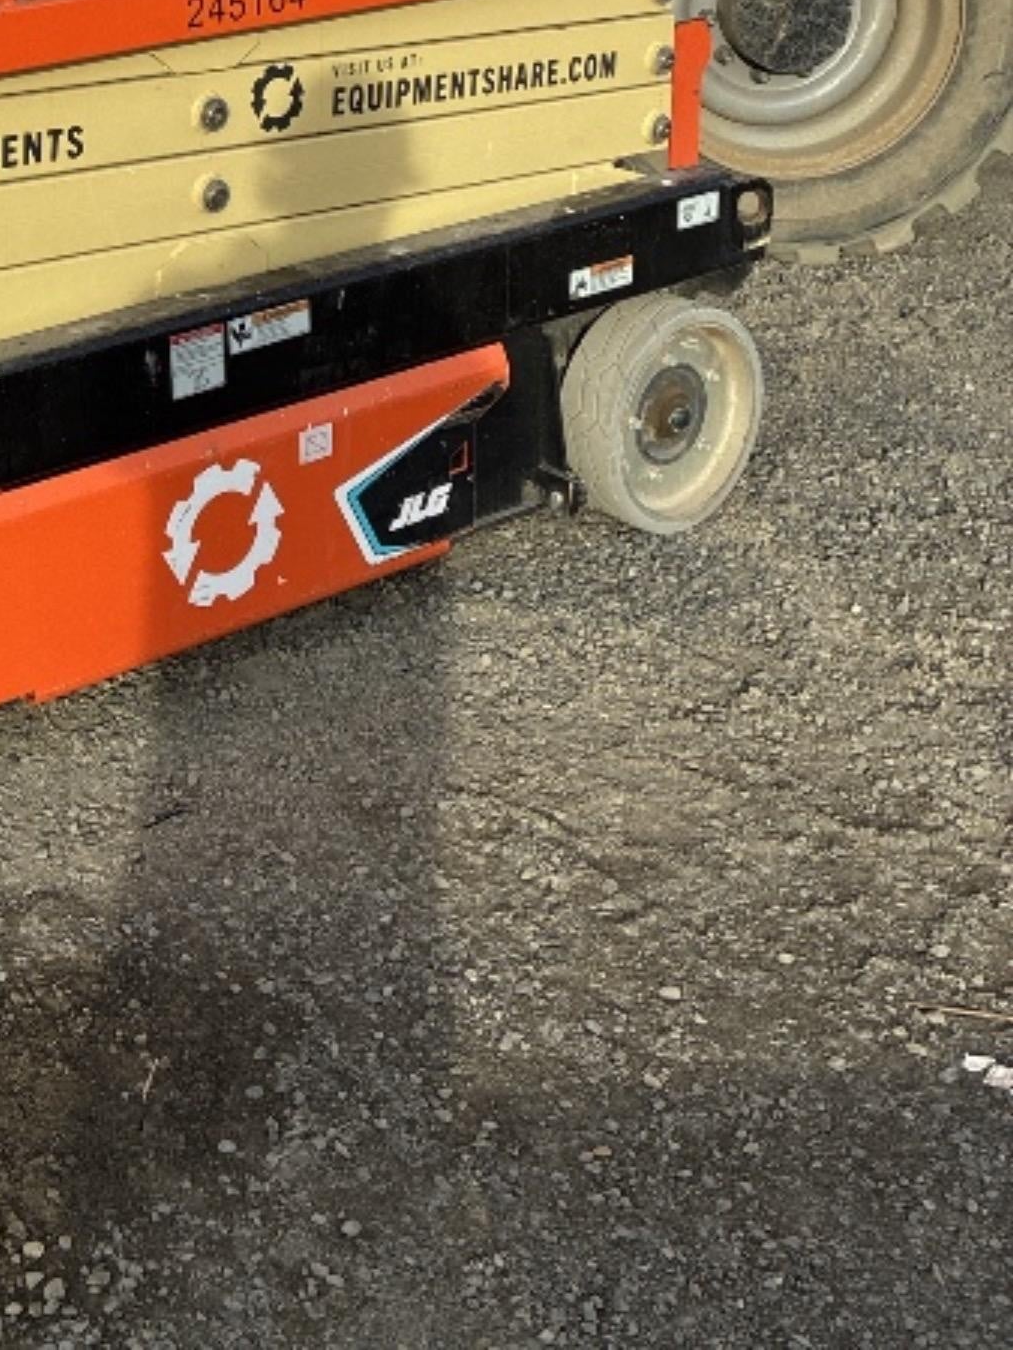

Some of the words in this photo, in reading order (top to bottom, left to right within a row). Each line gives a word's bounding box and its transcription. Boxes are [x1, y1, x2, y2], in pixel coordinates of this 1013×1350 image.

[331, 51, 617, 116] EQUIPMENTSHARE.COM
[332, 59, 370, 78] VISIT
[376, 56, 394, 73] US
[388, 482, 453, 532] JLG
